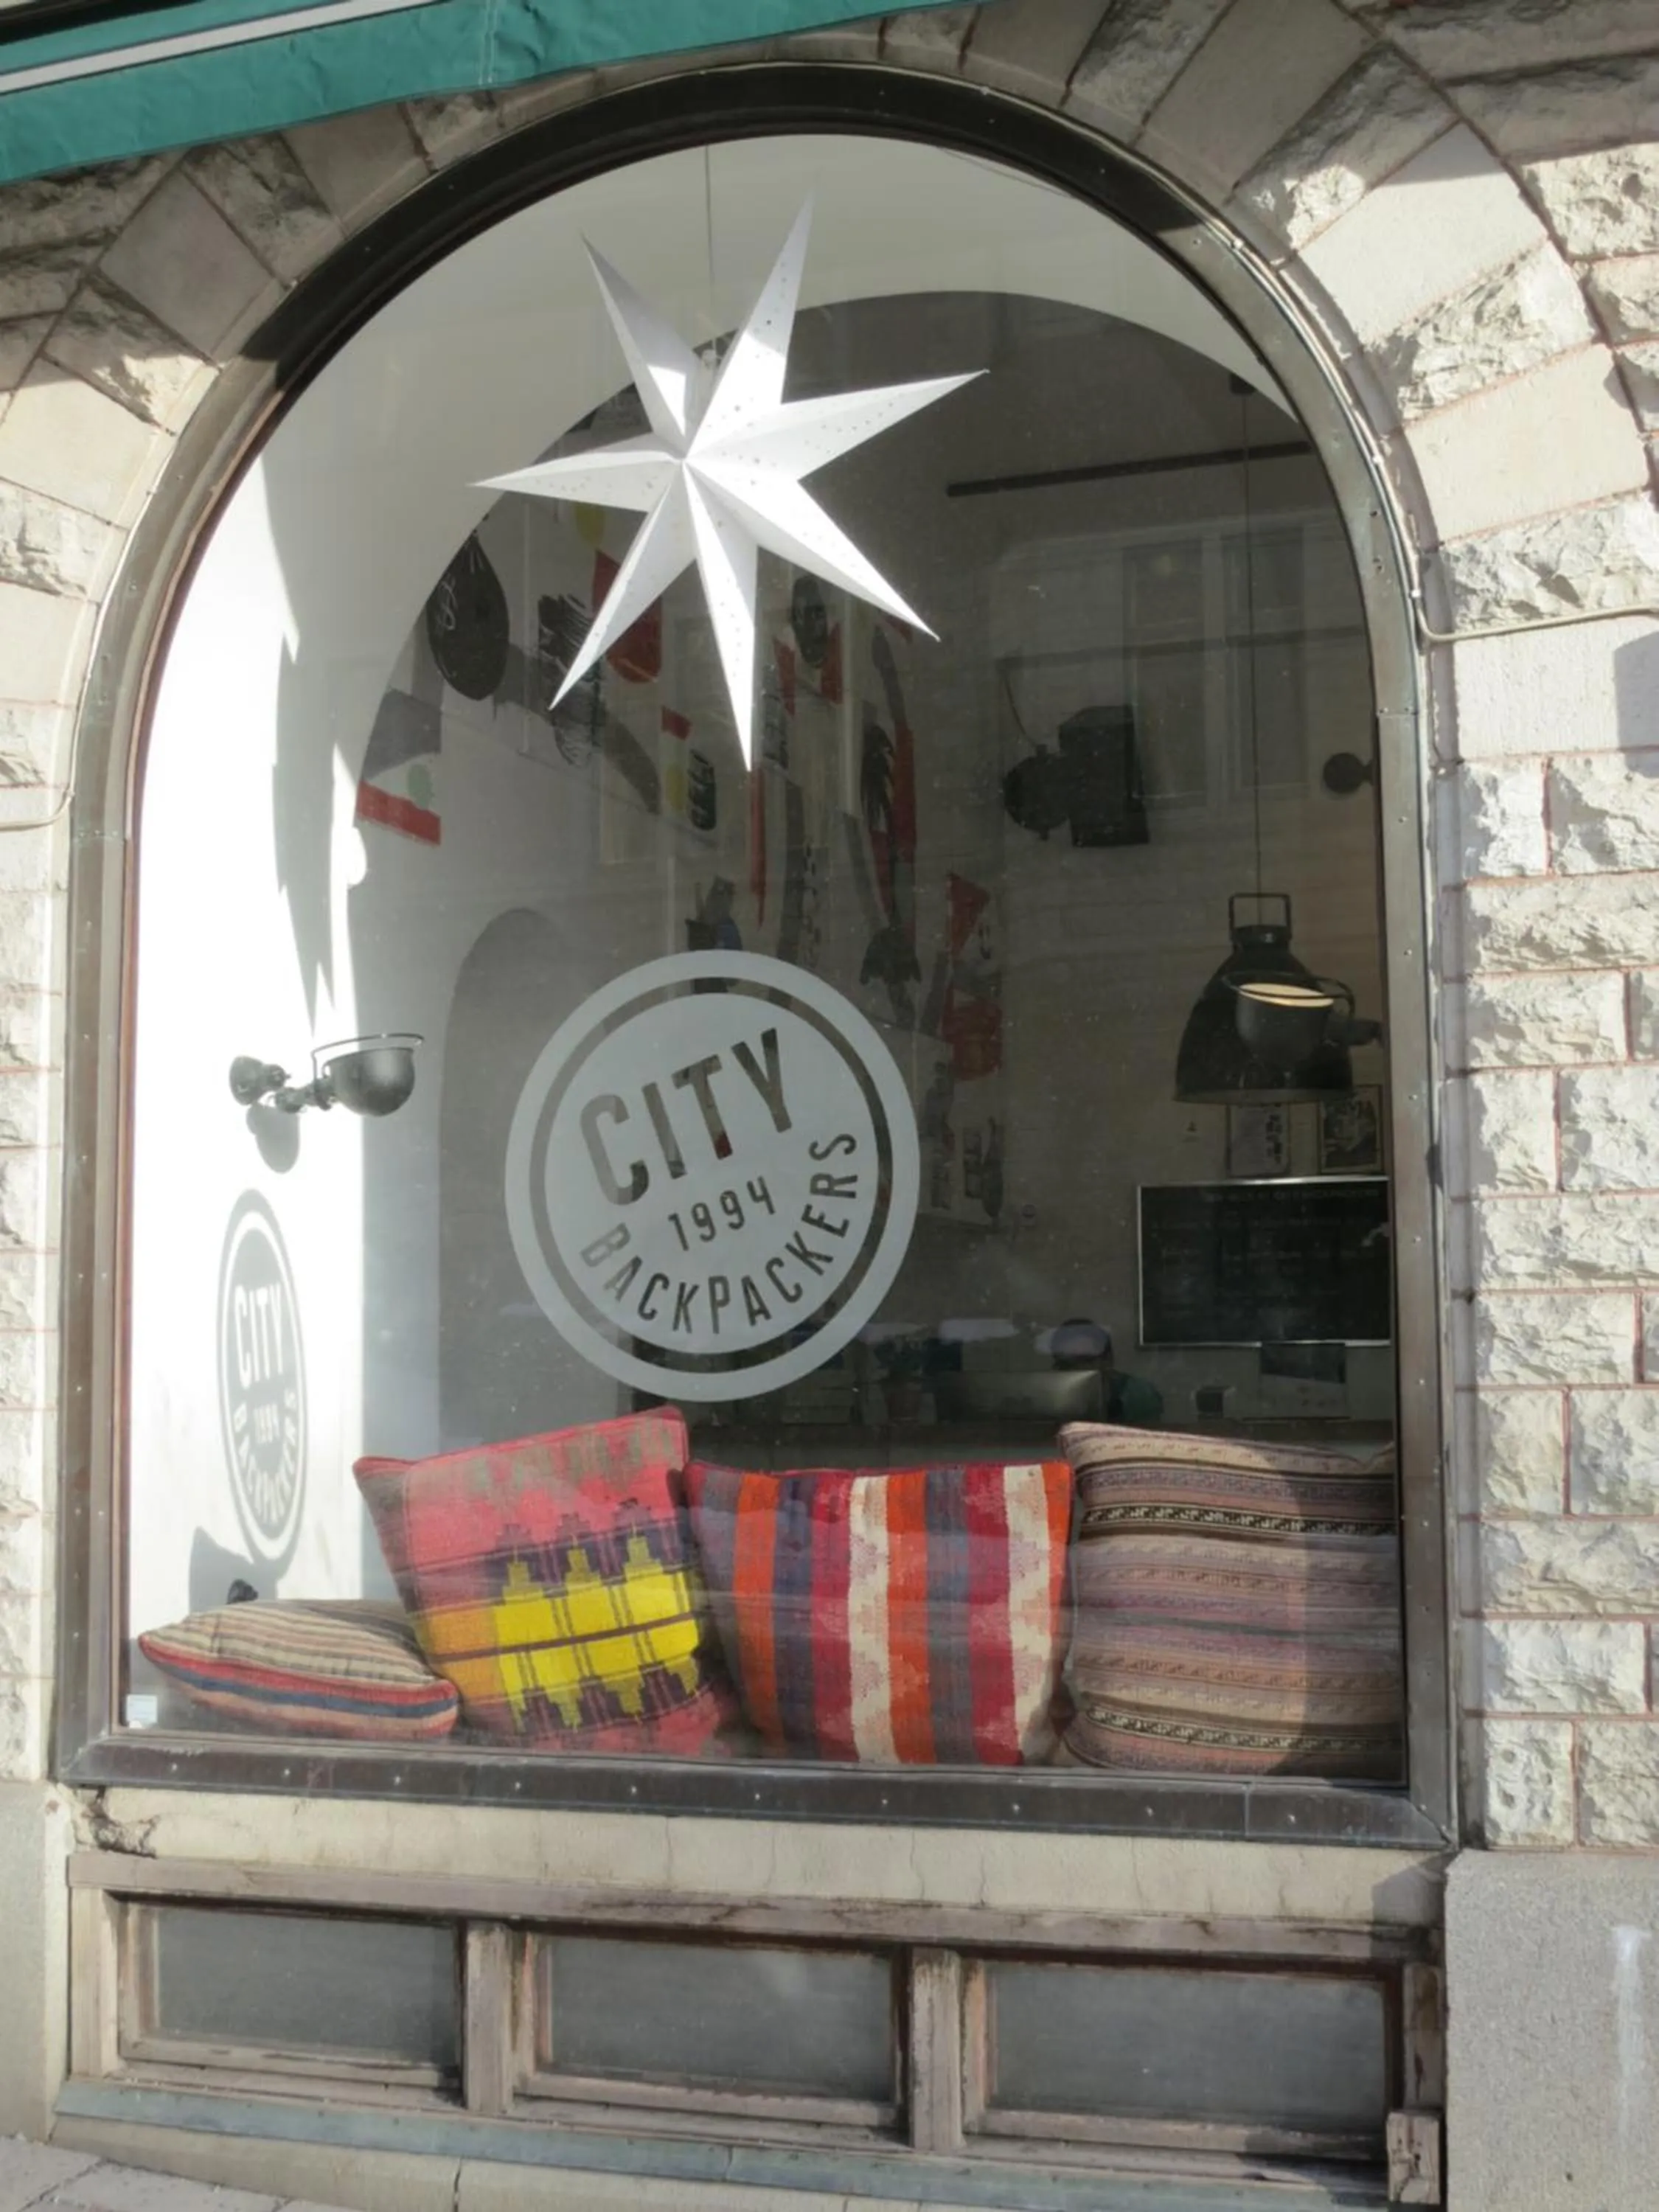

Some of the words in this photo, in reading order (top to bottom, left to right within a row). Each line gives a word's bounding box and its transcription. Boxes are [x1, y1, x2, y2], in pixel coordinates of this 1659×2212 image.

[580, 1029, 792, 1206] CITY
[580, 1134, 859, 1334] BACKPACKERS
[668, 1177, 776, 1251] 1994
[235, 1284, 284, 1388] CITY
